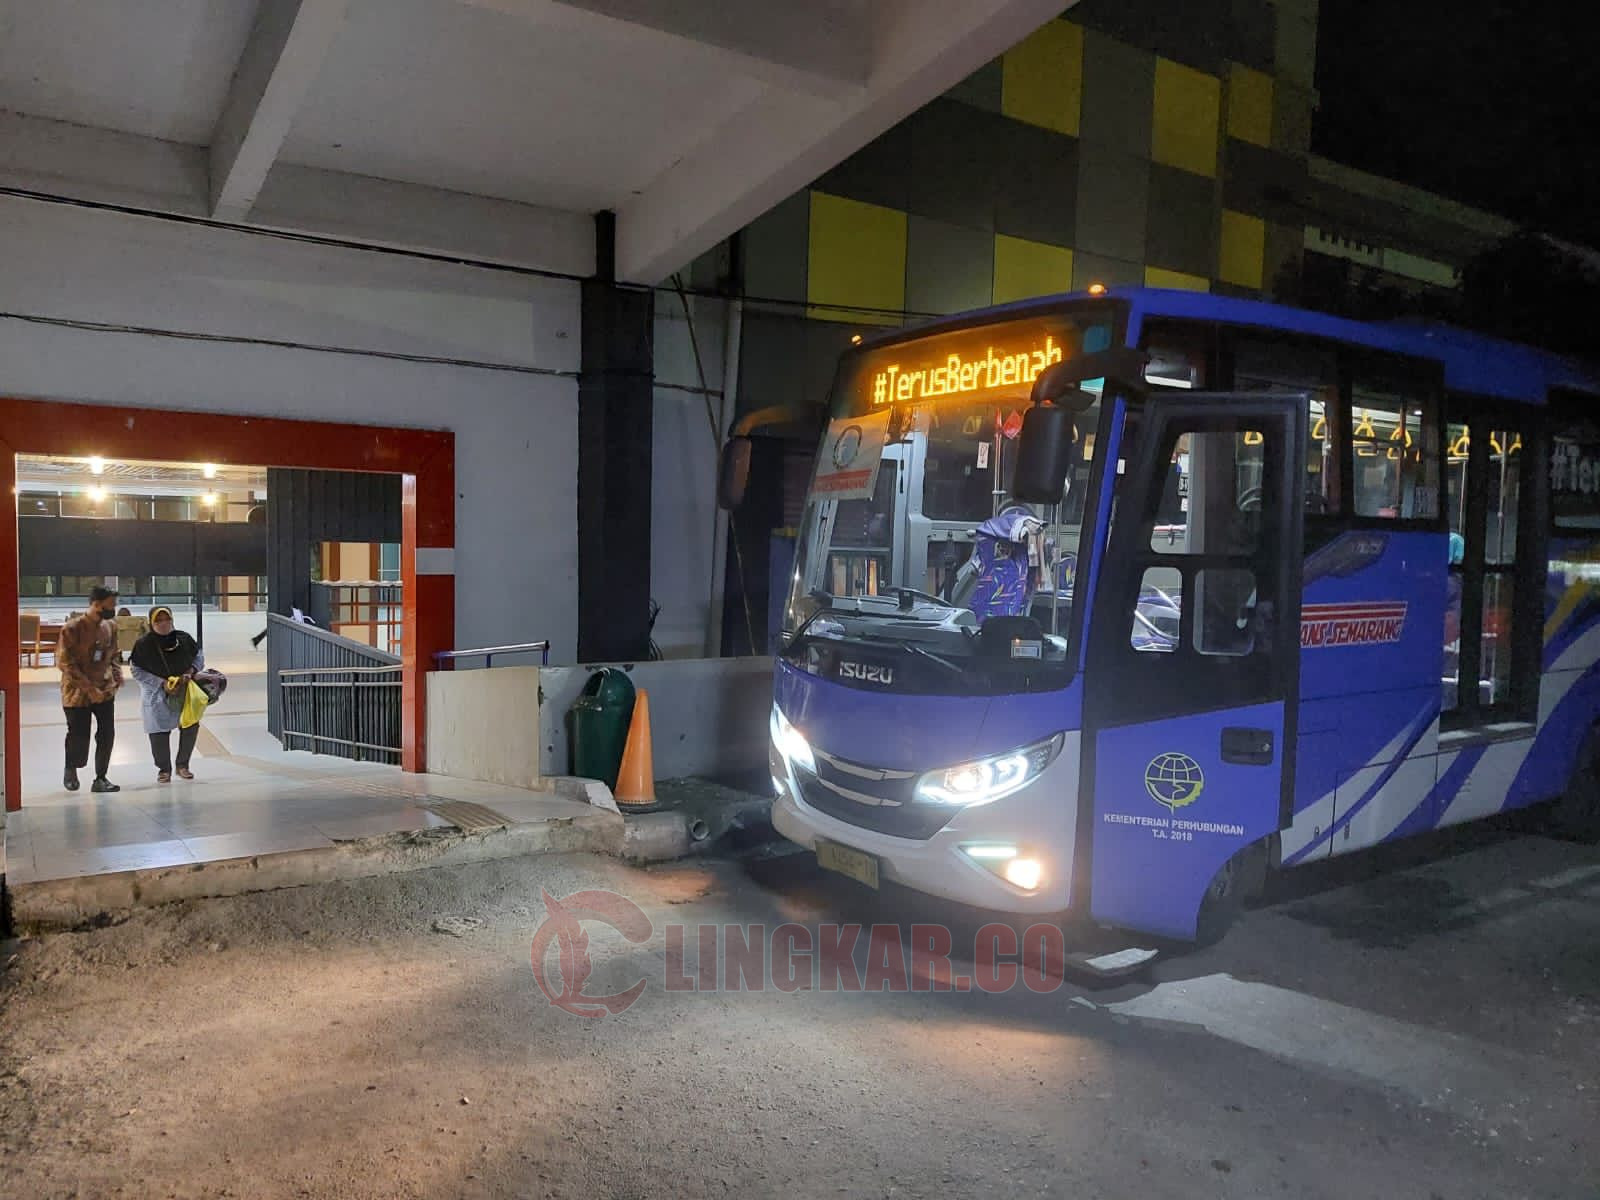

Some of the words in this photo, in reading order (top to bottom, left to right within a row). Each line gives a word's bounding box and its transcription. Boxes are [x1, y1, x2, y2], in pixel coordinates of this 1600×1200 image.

[839, 660, 894, 685] ISUZU
[1103, 813, 1169, 828] KEMENTERIAN
[1171, 819, 1244, 836] PERHUBUNGAN
[1151, 828, 1168, 839] T.A.
[1170, 830, 1193, 841] 2018
